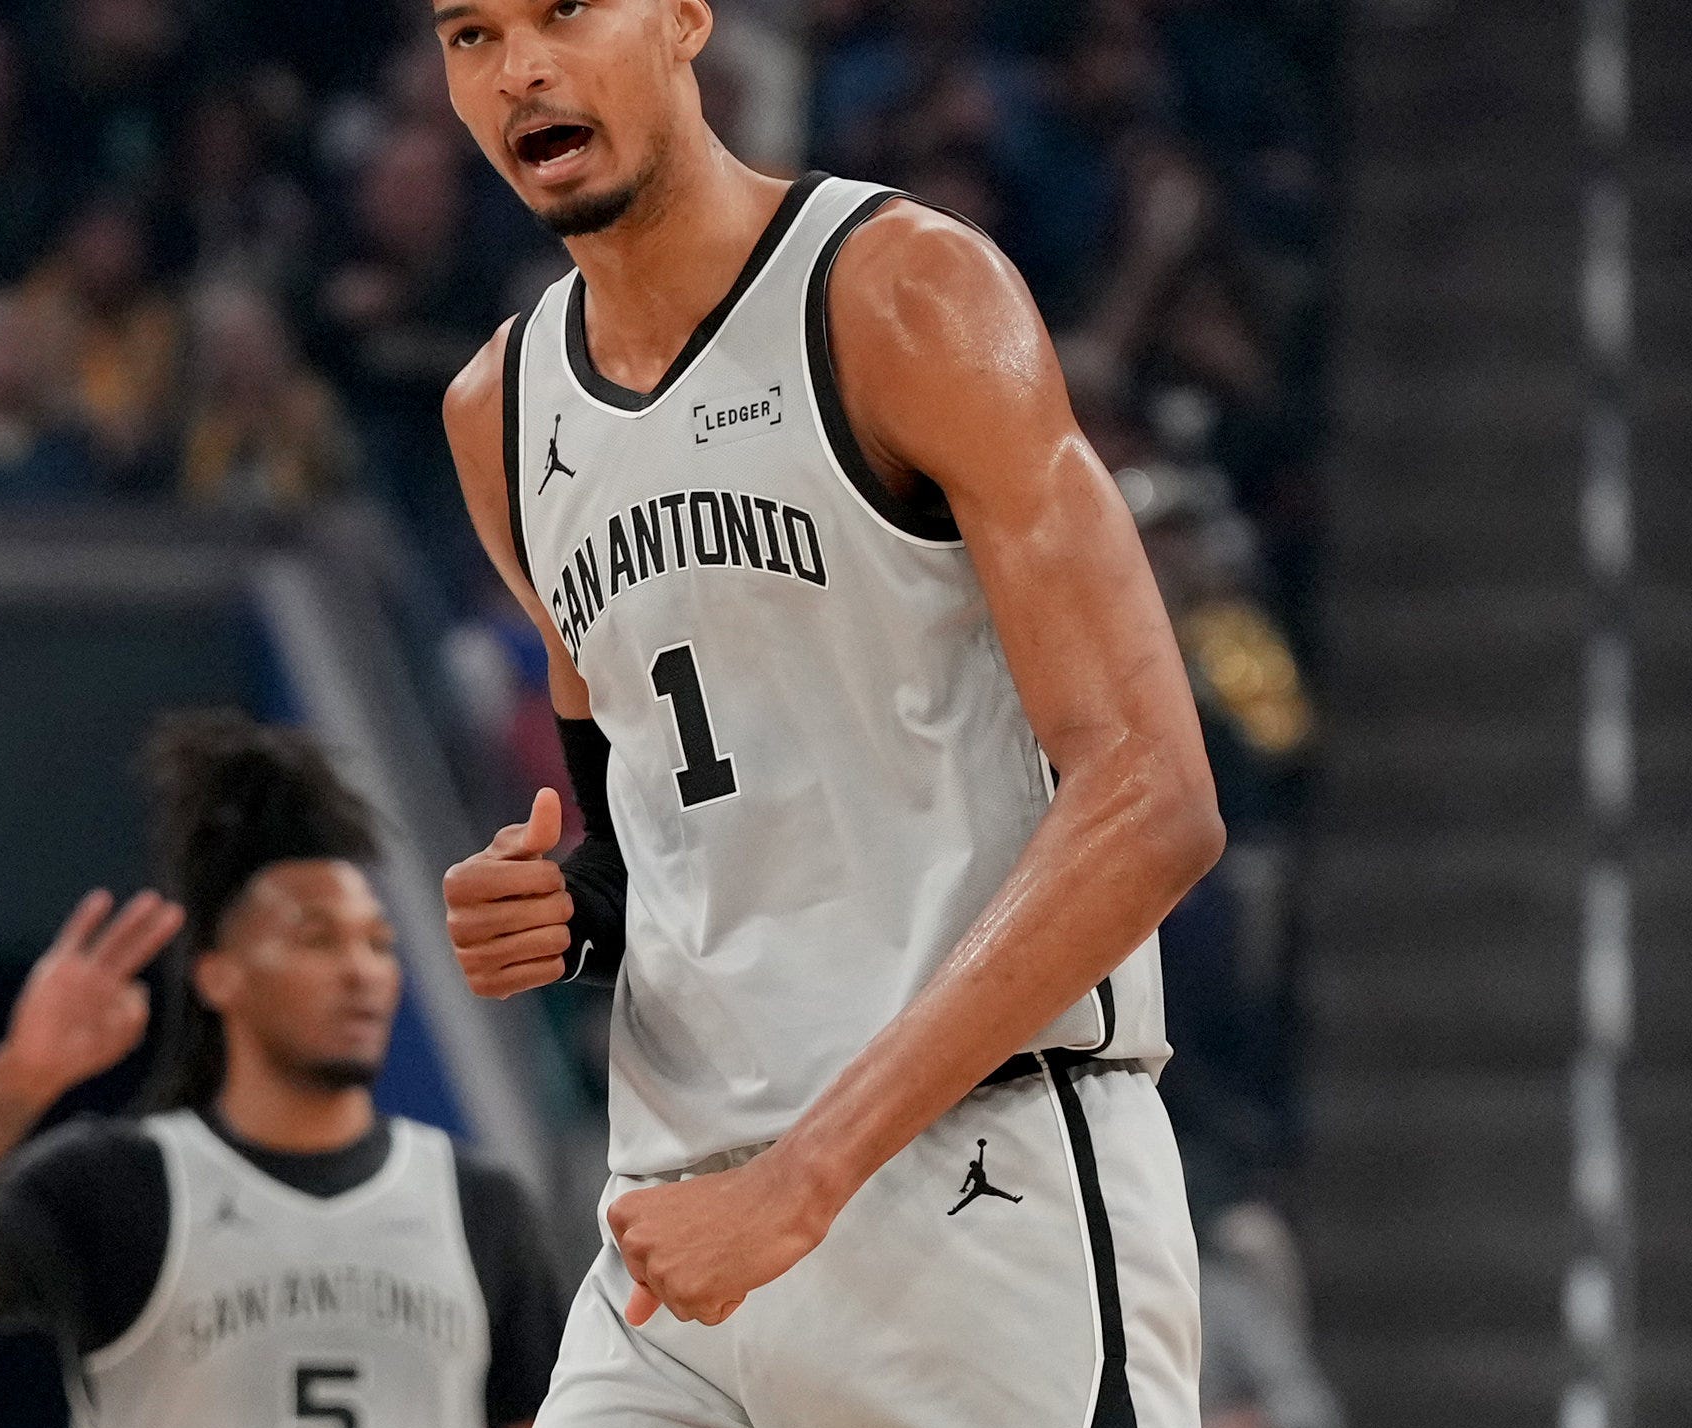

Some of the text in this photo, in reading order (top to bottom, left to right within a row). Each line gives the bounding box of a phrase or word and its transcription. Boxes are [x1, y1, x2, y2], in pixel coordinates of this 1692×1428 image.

[705, 401, 771, 431] LEDGER
[607, 489, 829, 600] ANTONIO
[647, 640, 741, 813] 1
